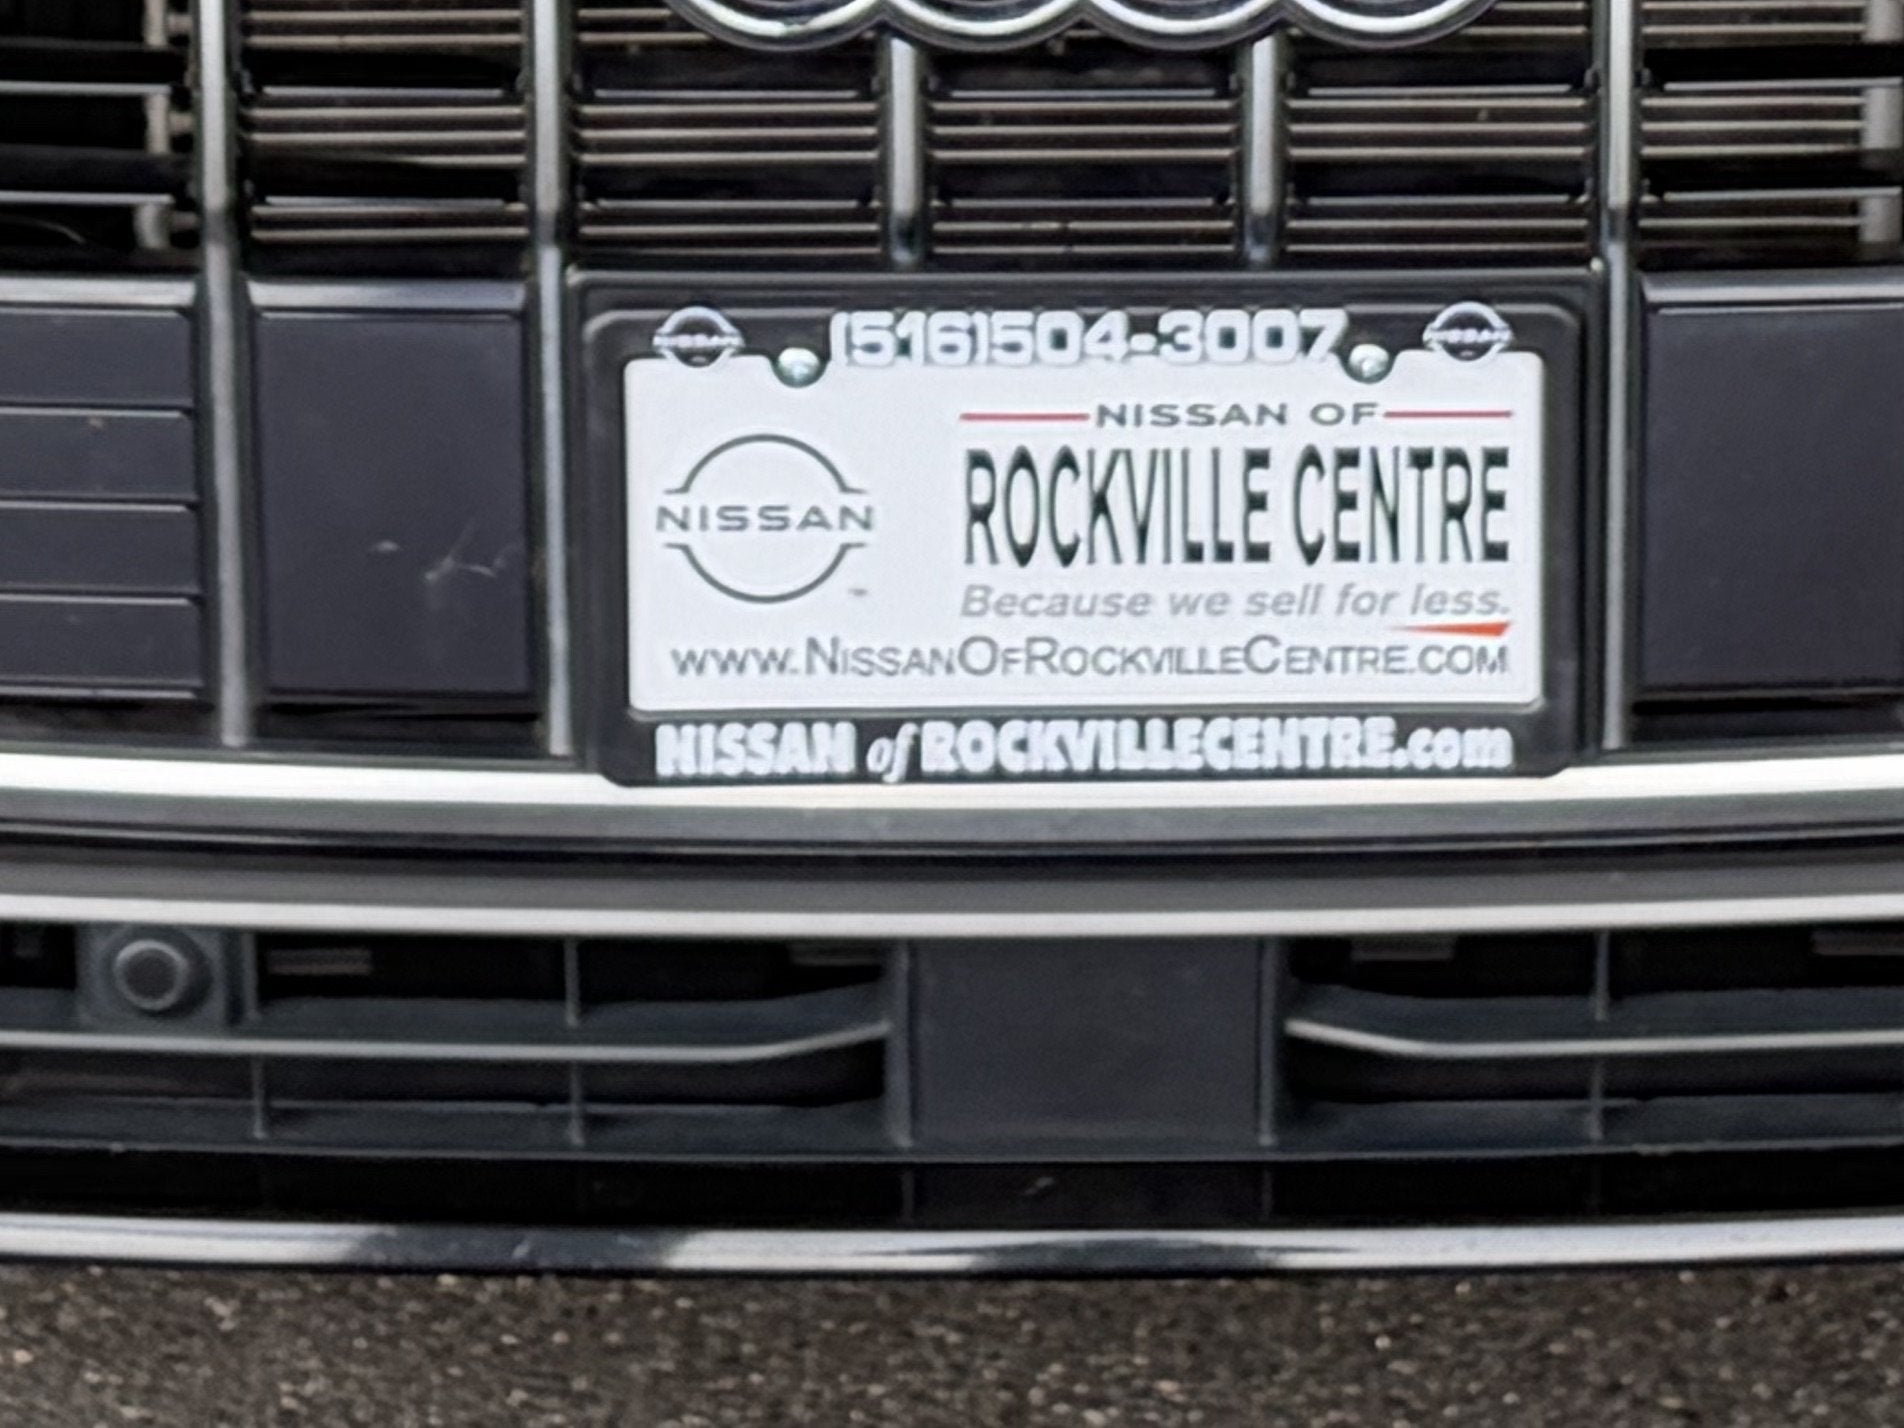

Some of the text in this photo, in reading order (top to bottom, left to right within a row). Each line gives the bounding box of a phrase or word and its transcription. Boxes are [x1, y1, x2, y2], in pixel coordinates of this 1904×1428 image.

[829, 308, 1349, 367] (516)504-3007
[1097, 401, 1381, 428] NISSAN OF
[655, 504, 875, 533] NISSAN
[963, 444, 1510, 569] ROCKVILLE CENTRE
[959, 581, 1512, 619] Because we sell for less.
[654, 715, 1514, 785] NISSAN of ROCKVILLECENTRE.com
